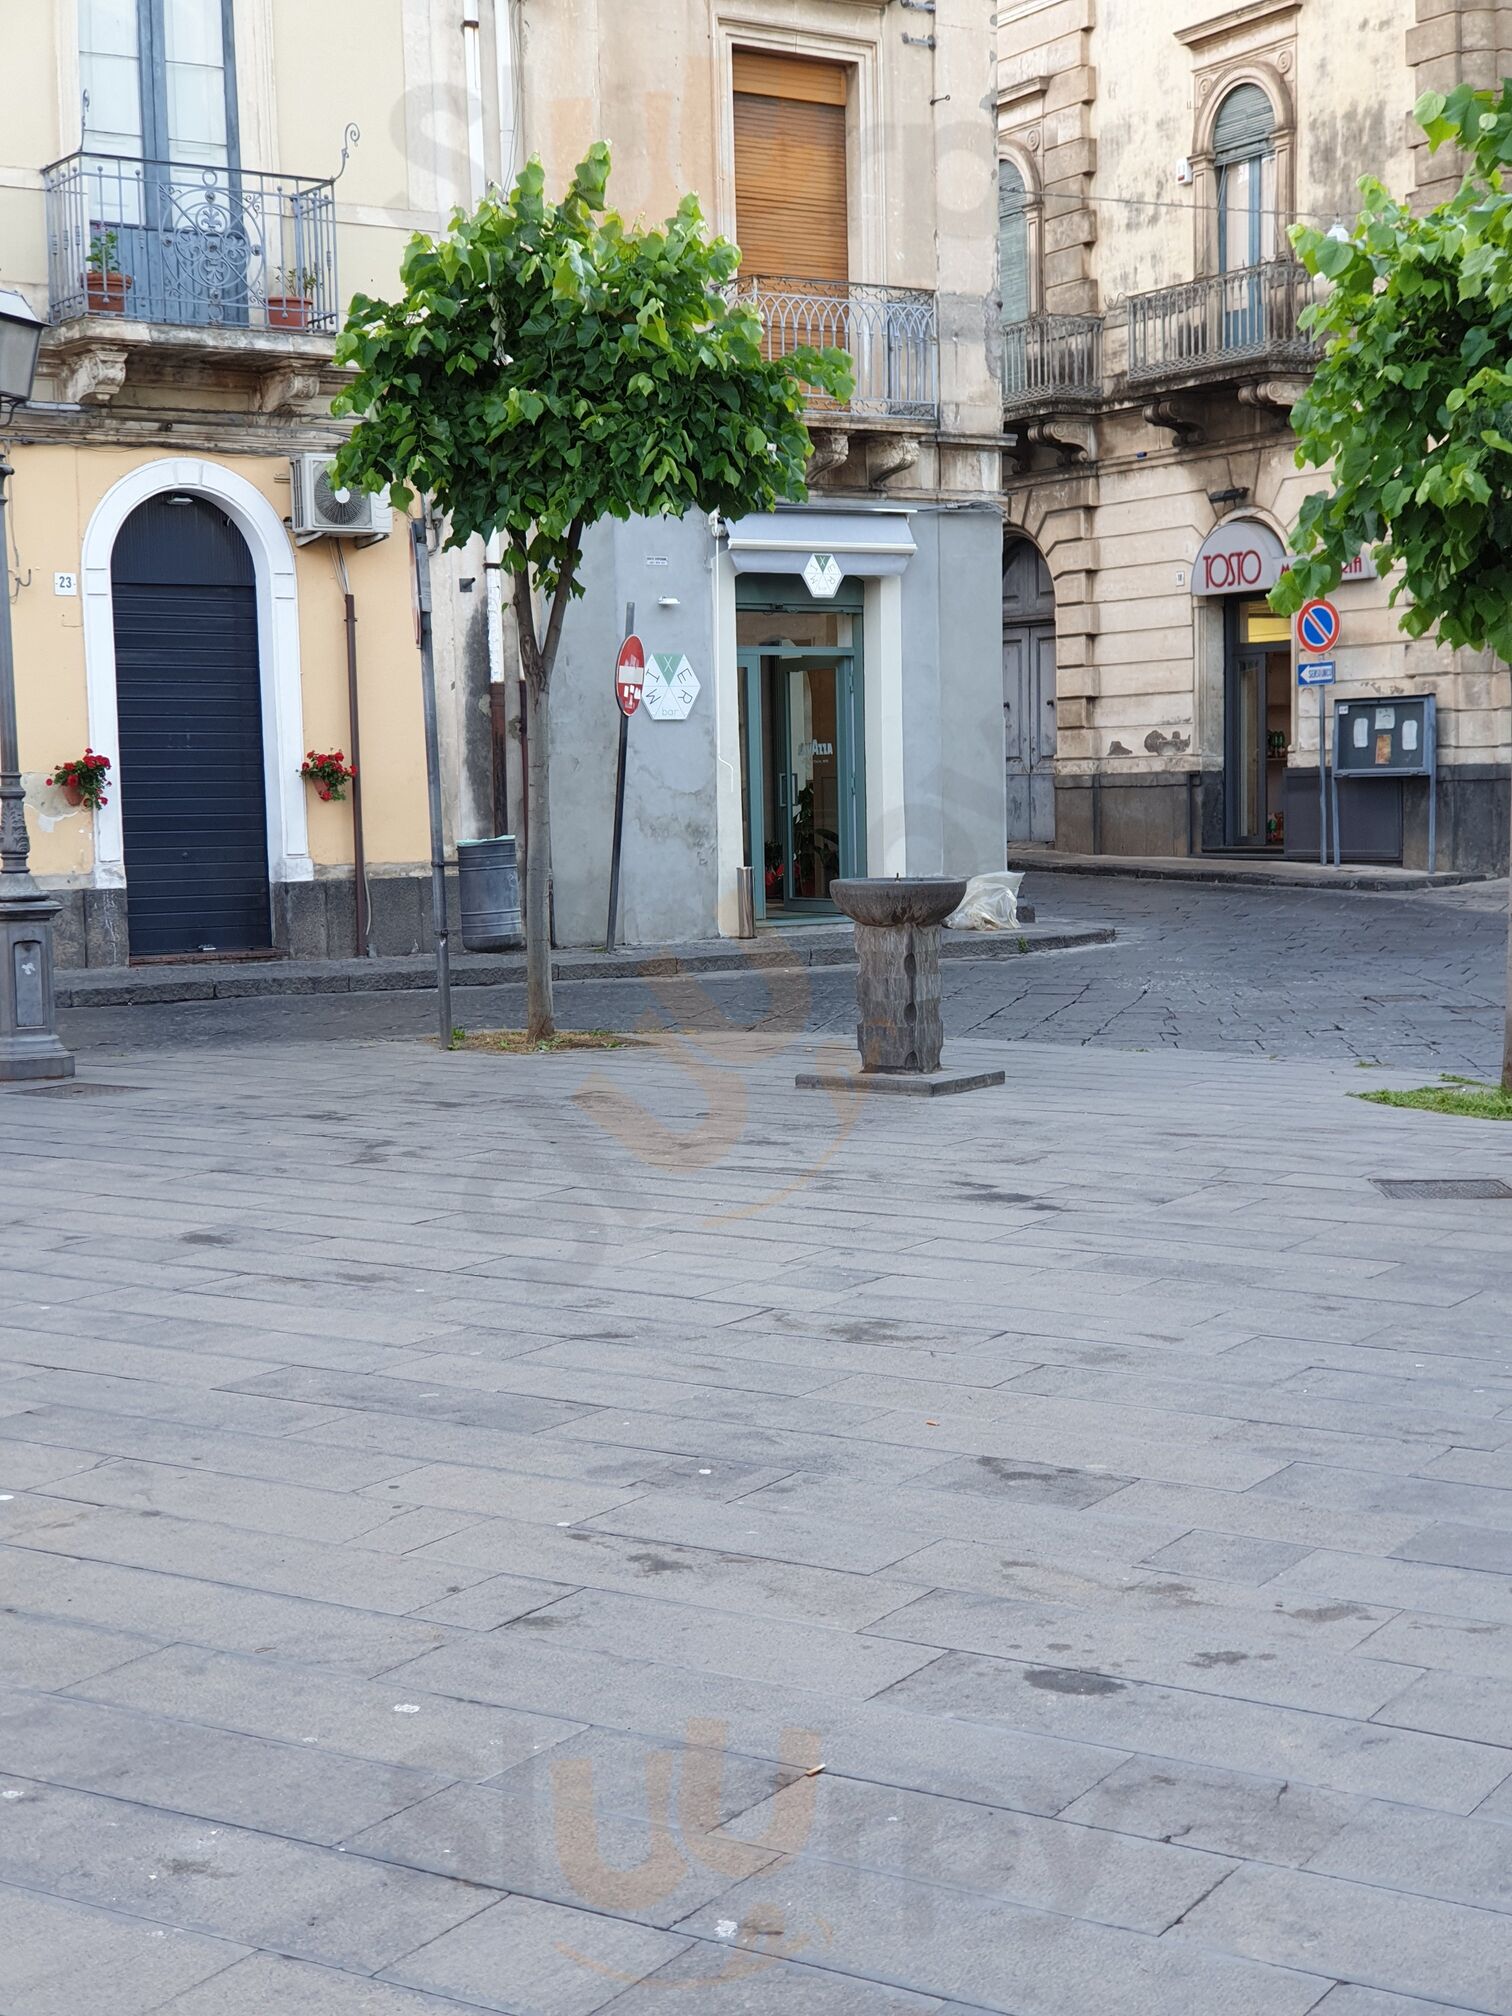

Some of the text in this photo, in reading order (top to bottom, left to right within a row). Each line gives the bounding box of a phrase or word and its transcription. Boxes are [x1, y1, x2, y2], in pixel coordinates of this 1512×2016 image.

[1203, 550, 1262, 588] TOSTO
[59, 575, 72, 589] 23
[662, 707, 680, 716] bar
